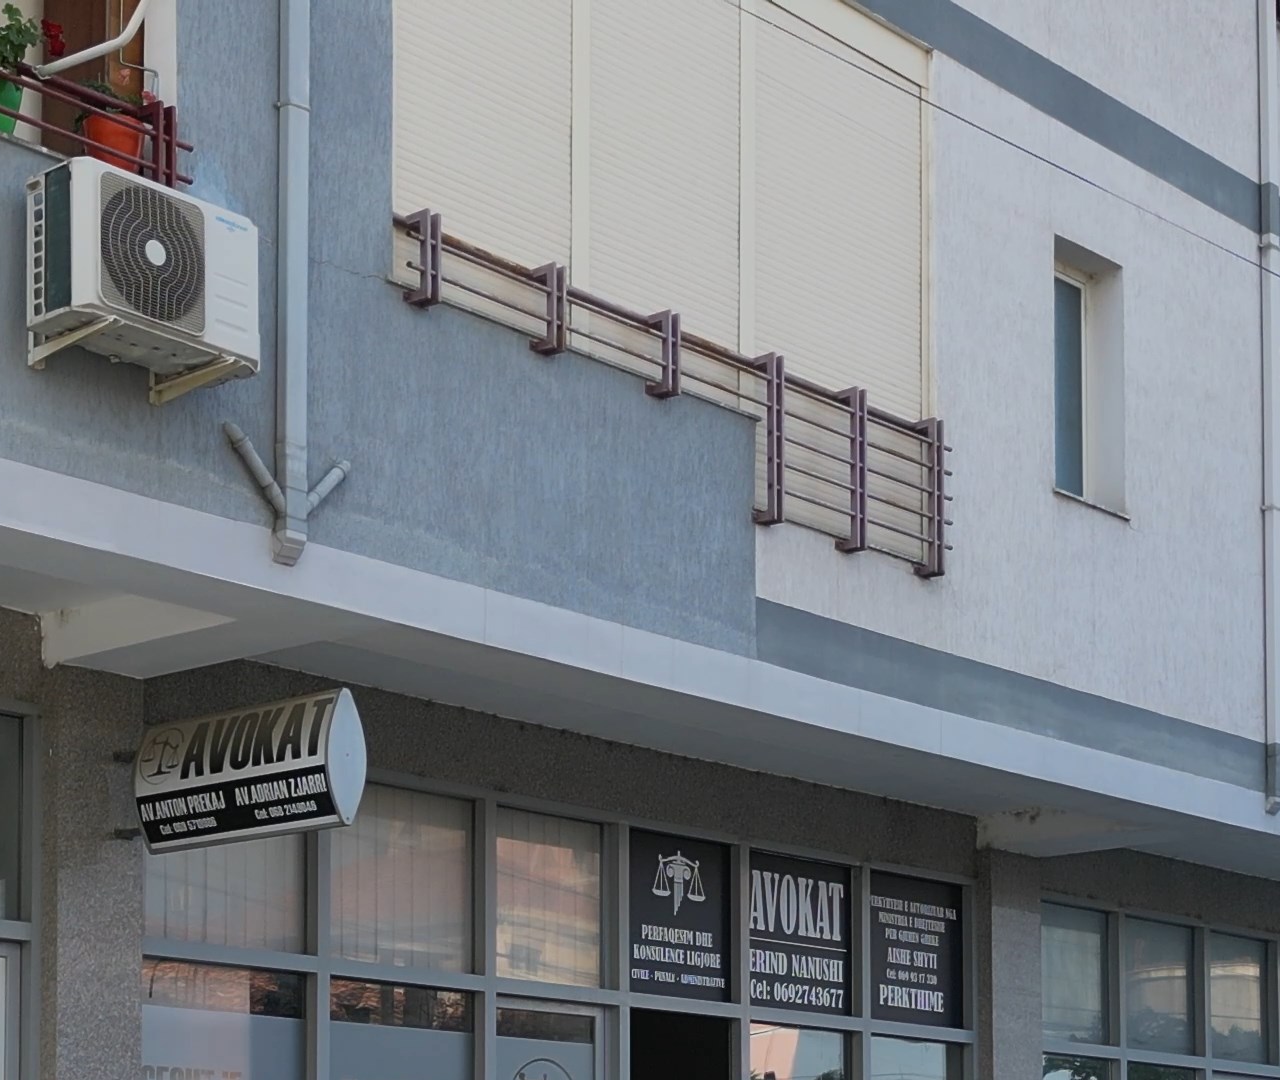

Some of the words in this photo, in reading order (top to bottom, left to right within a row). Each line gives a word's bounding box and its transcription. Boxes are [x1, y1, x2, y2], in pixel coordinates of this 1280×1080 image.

[180, 697, 334, 780] AVOKAT
[187, 790, 225, 814] PREKAJ
[235, 780, 289, 806] AV.ADRIAN
[288, 773, 327, 797] ZJARRI
[749, 869, 844, 941] AVOKAT
[695, 931, 713, 948] DHE
[633, 944, 685, 965] KONSULENCE
[687, 950, 721, 969] LIGJORE
[749, 948, 788, 976] ERIND
[791, 953, 843, 983] NANUSHI
[887, 947, 911, 966] AISHE
[913, 951, 937, 969] SHYTI
[750, 979, 771, 1000] Cel:
[773, 982, 844, 1009] 0692743677
[879, 984, 944, 1013] PERKTHIME
